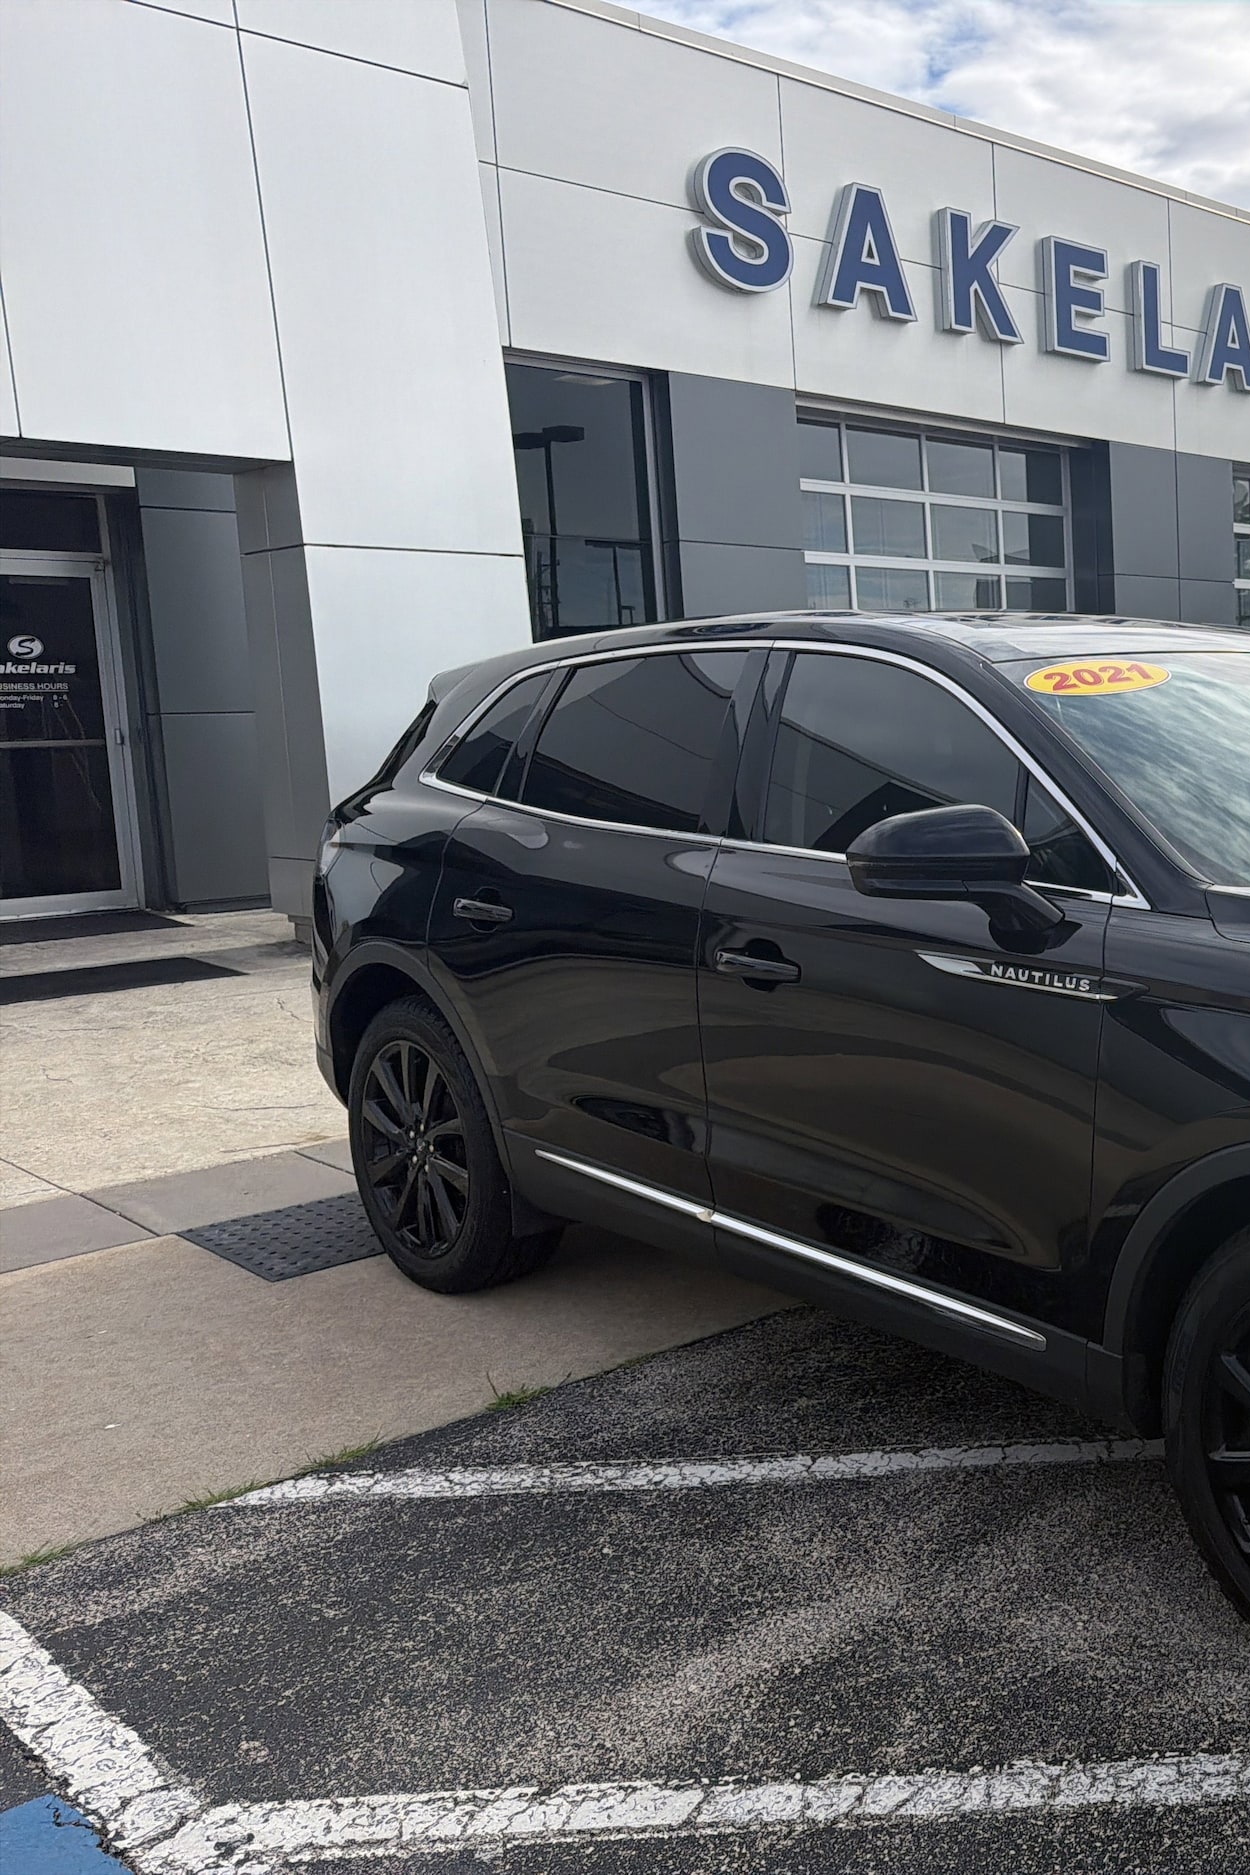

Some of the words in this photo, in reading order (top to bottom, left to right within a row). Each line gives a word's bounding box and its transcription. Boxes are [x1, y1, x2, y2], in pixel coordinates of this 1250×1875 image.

[37, 682, 69, 690] HOURS
[1043, 663, 1153, 692] 2021
[991, 963, 1091, 992] NAUTILUS
